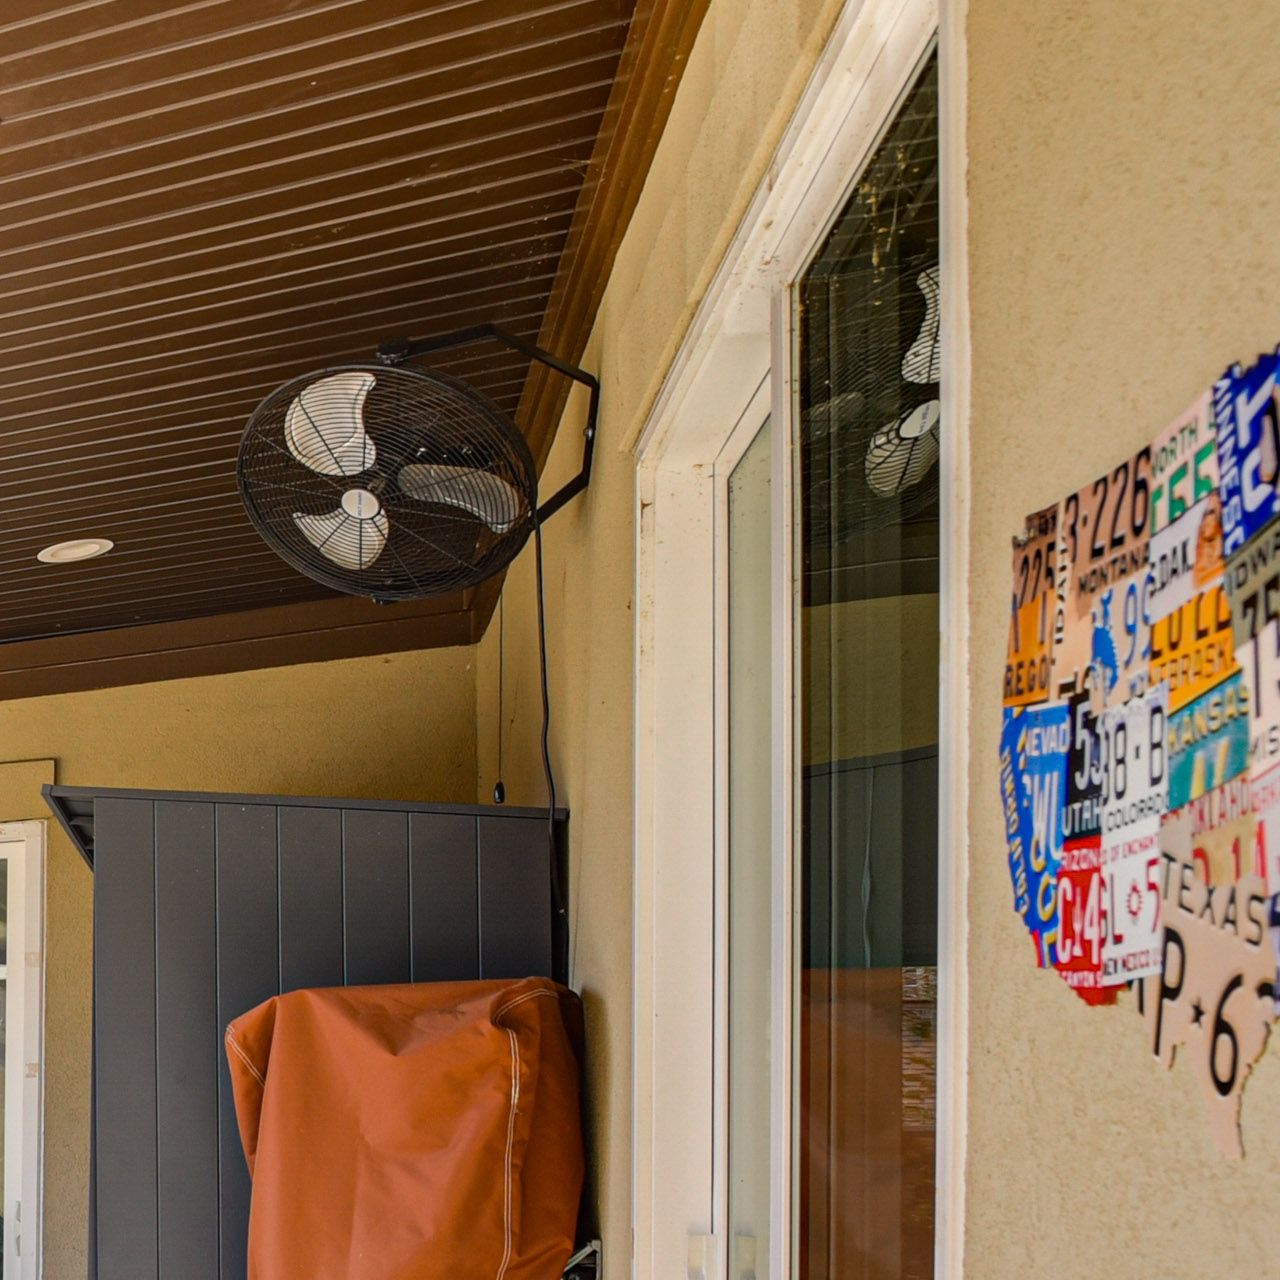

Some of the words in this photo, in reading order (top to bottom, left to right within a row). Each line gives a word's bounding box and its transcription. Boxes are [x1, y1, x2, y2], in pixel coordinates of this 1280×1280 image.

[1168, 684, 1249, 757] KANSAS
[1062, 798, 1102, 837] UTAH
[1162, 851, 1267, 947] TEXAS
